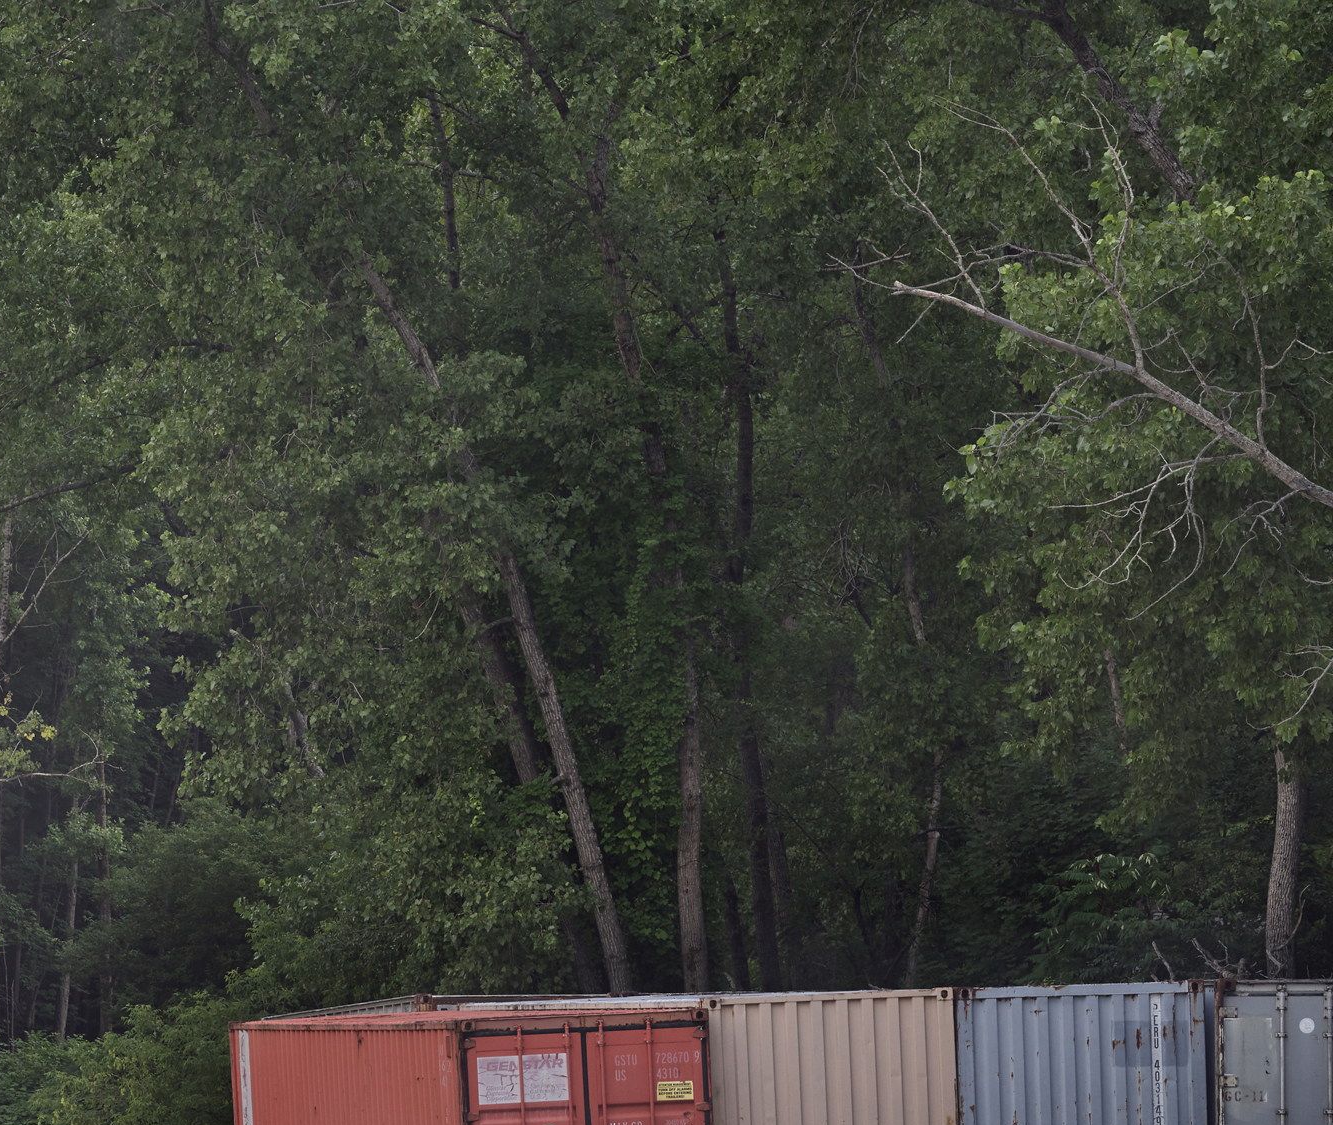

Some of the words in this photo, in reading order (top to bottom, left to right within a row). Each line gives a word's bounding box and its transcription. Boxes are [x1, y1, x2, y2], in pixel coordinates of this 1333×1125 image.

[614, 1054, 638, 1067] GSTU
[655, 1051, 690, 1064] 728670
[615, 1069, 627, 1081] US
[656, 1067, 679, 1079] 4310
